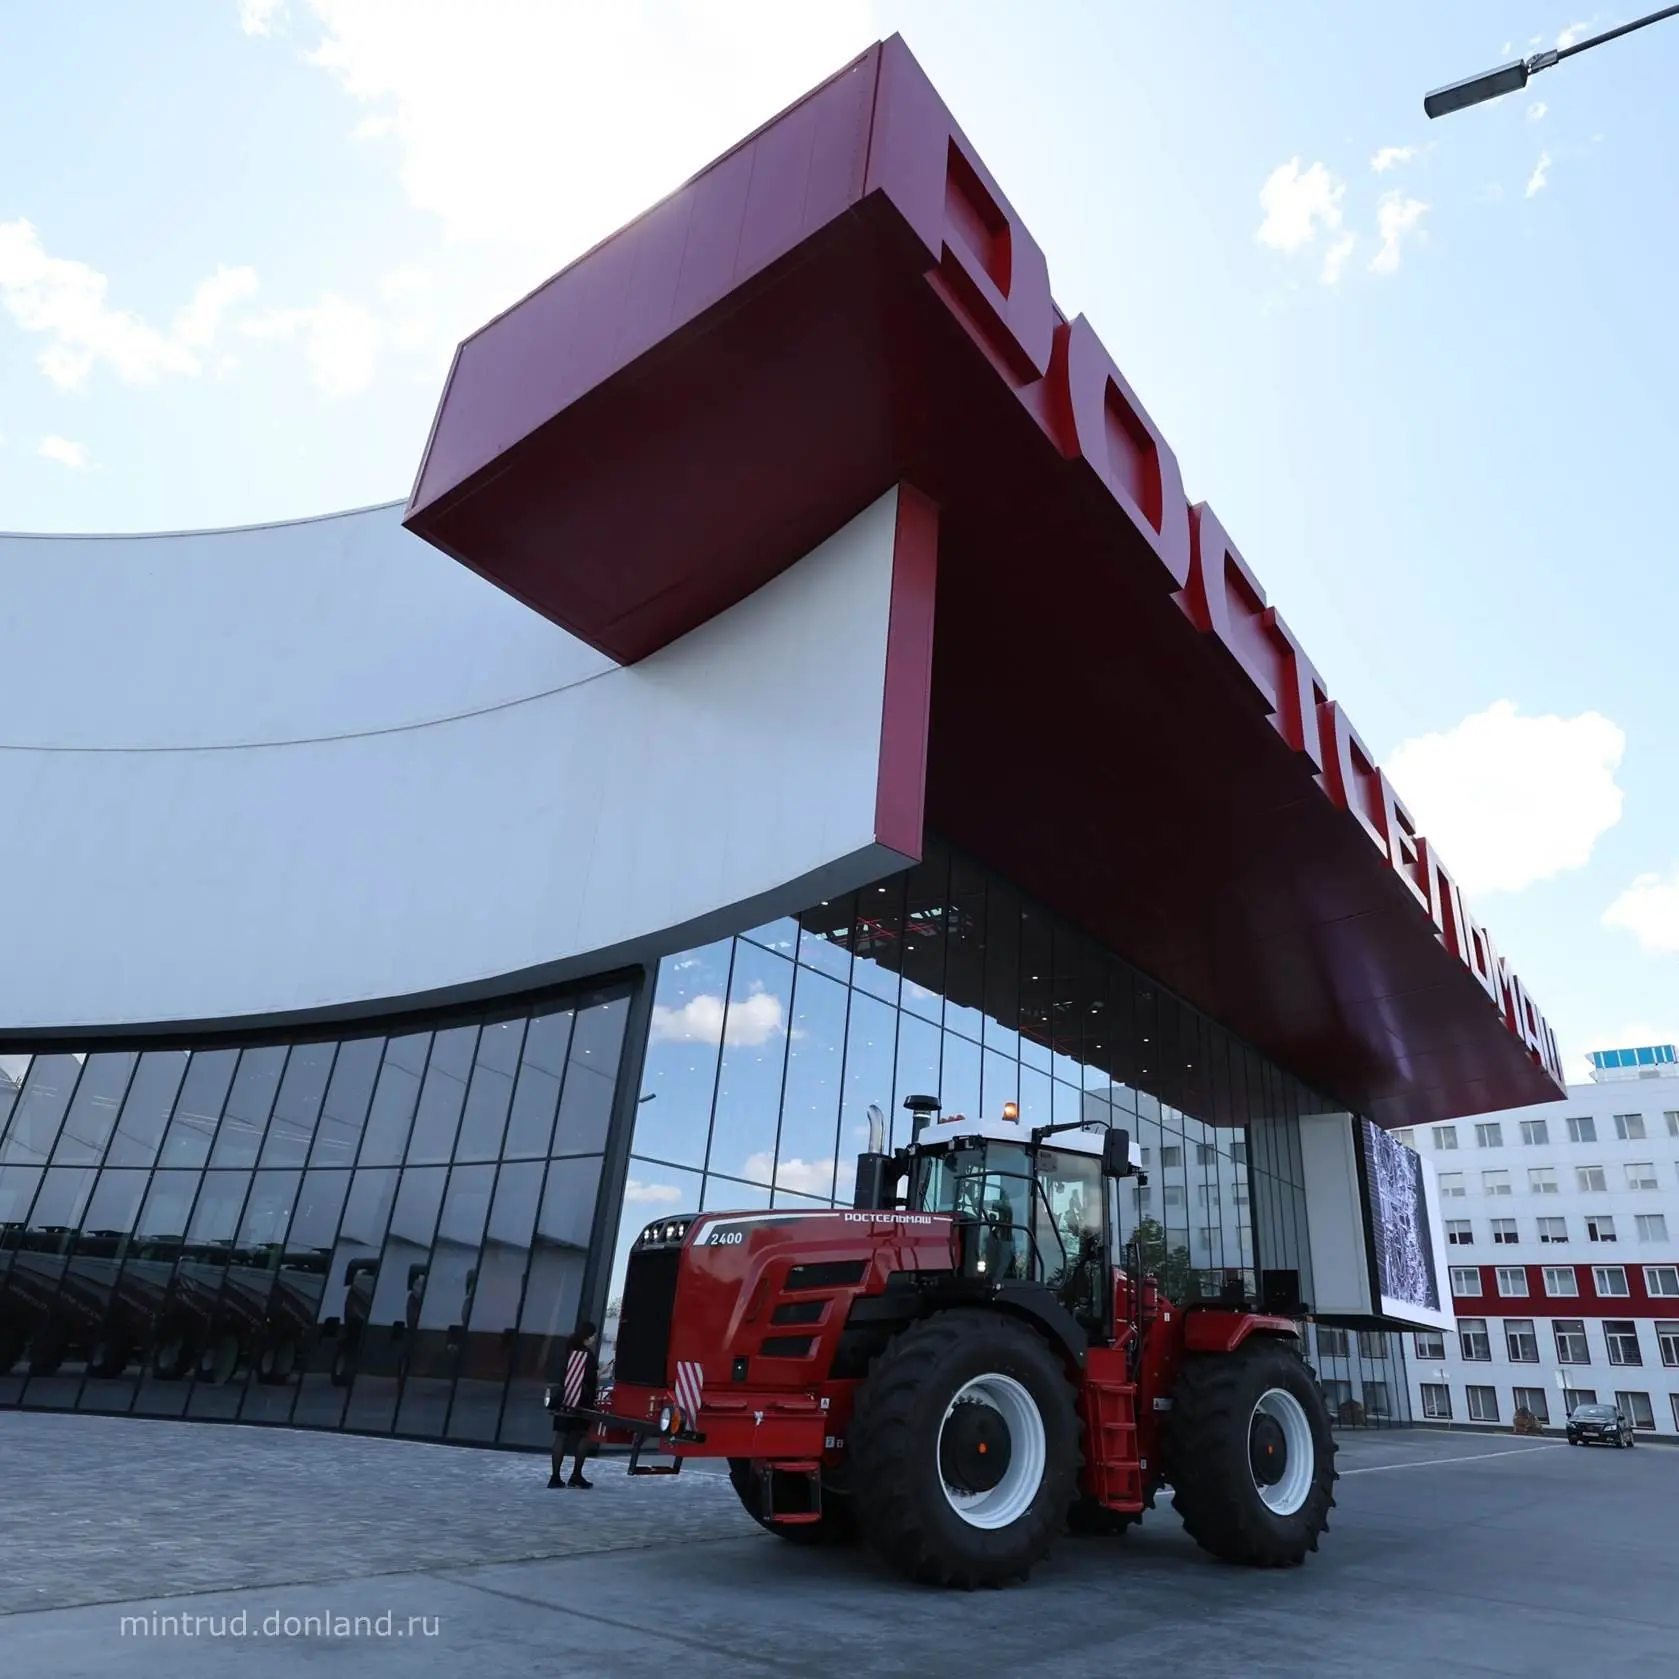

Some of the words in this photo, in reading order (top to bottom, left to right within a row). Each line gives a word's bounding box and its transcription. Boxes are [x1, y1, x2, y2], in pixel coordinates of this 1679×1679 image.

[865, 31, 1568, 1100] РОСТСЕЛЬМАШ
[844, 1213, 932, 1224] РОСТСЕЛЬМАШ
[710, 1232, 743, 1245] 2400
